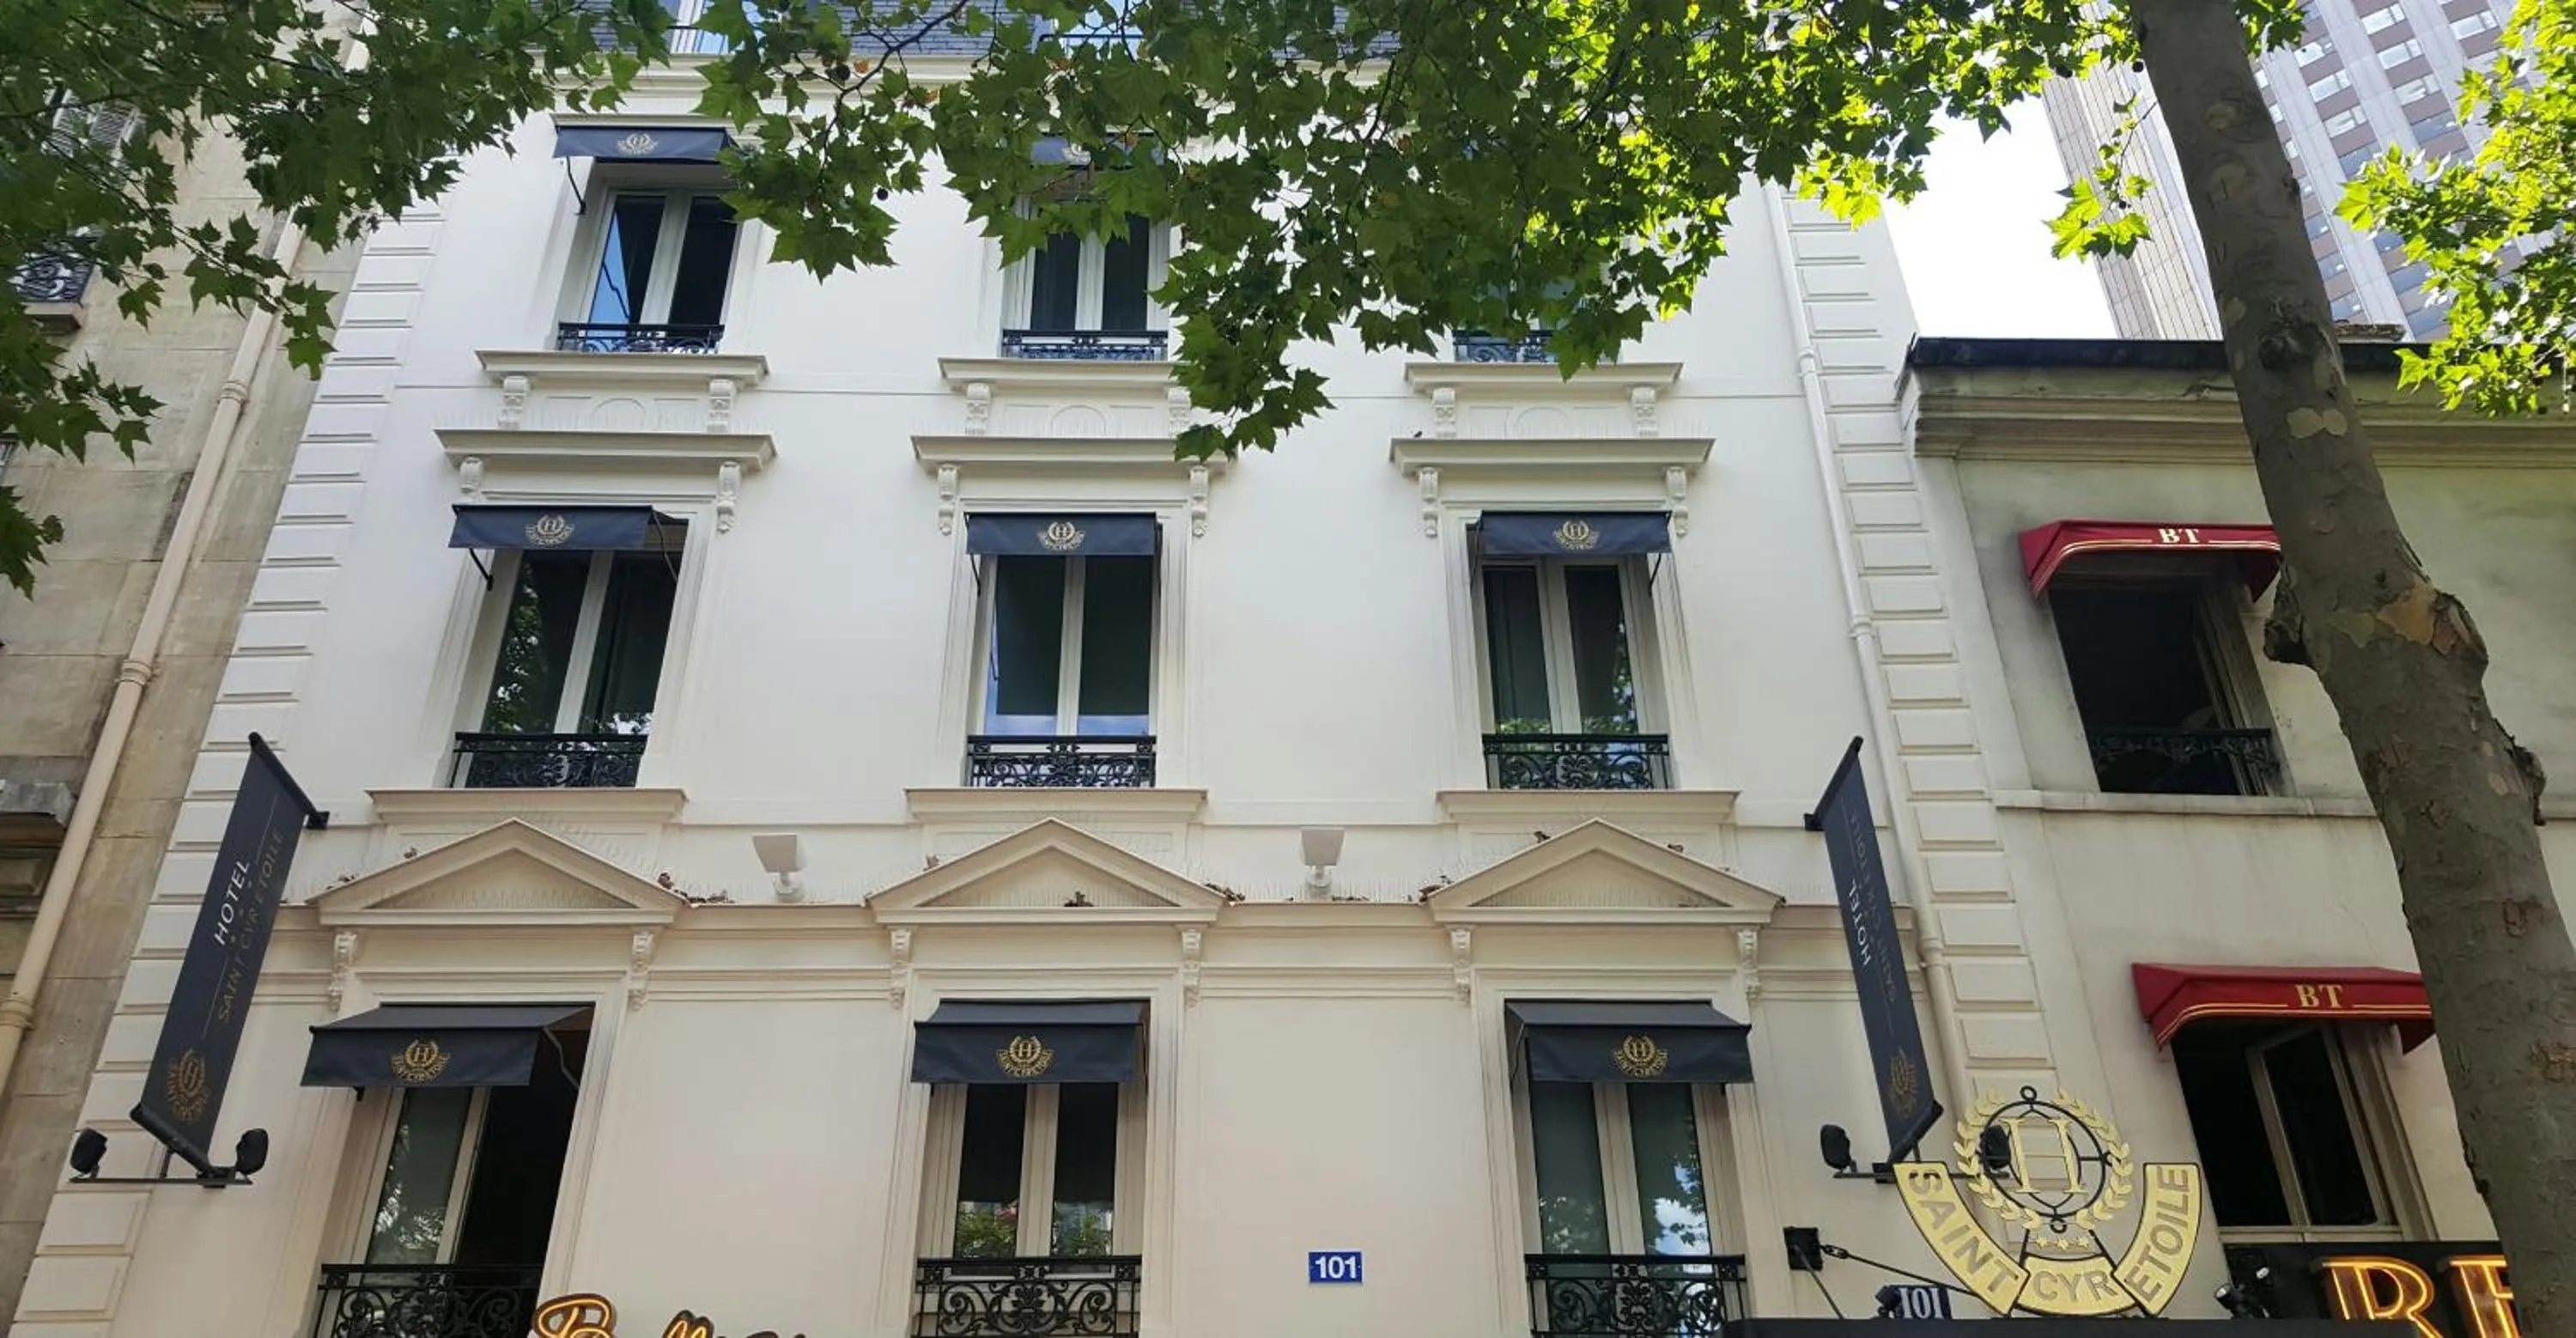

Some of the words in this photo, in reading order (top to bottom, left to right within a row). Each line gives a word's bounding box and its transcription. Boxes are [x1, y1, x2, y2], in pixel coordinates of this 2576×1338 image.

[2157, 527, 2200, 544] BT
[214, 860, 251, 946] HOTEL
[1849, 879, 1872, 966] HOTEL
[2293, 984, 2343, 1008] BT
[1908, 1168, 2020, 1295] SAINT
[2030, 1269, 2119, 1304] CYR
[2123, 1165, 2191, 1304] ETOILE
[1315, 1255, 1357, 1279] 101
[1898, 1286, 1945, 1319] 101
